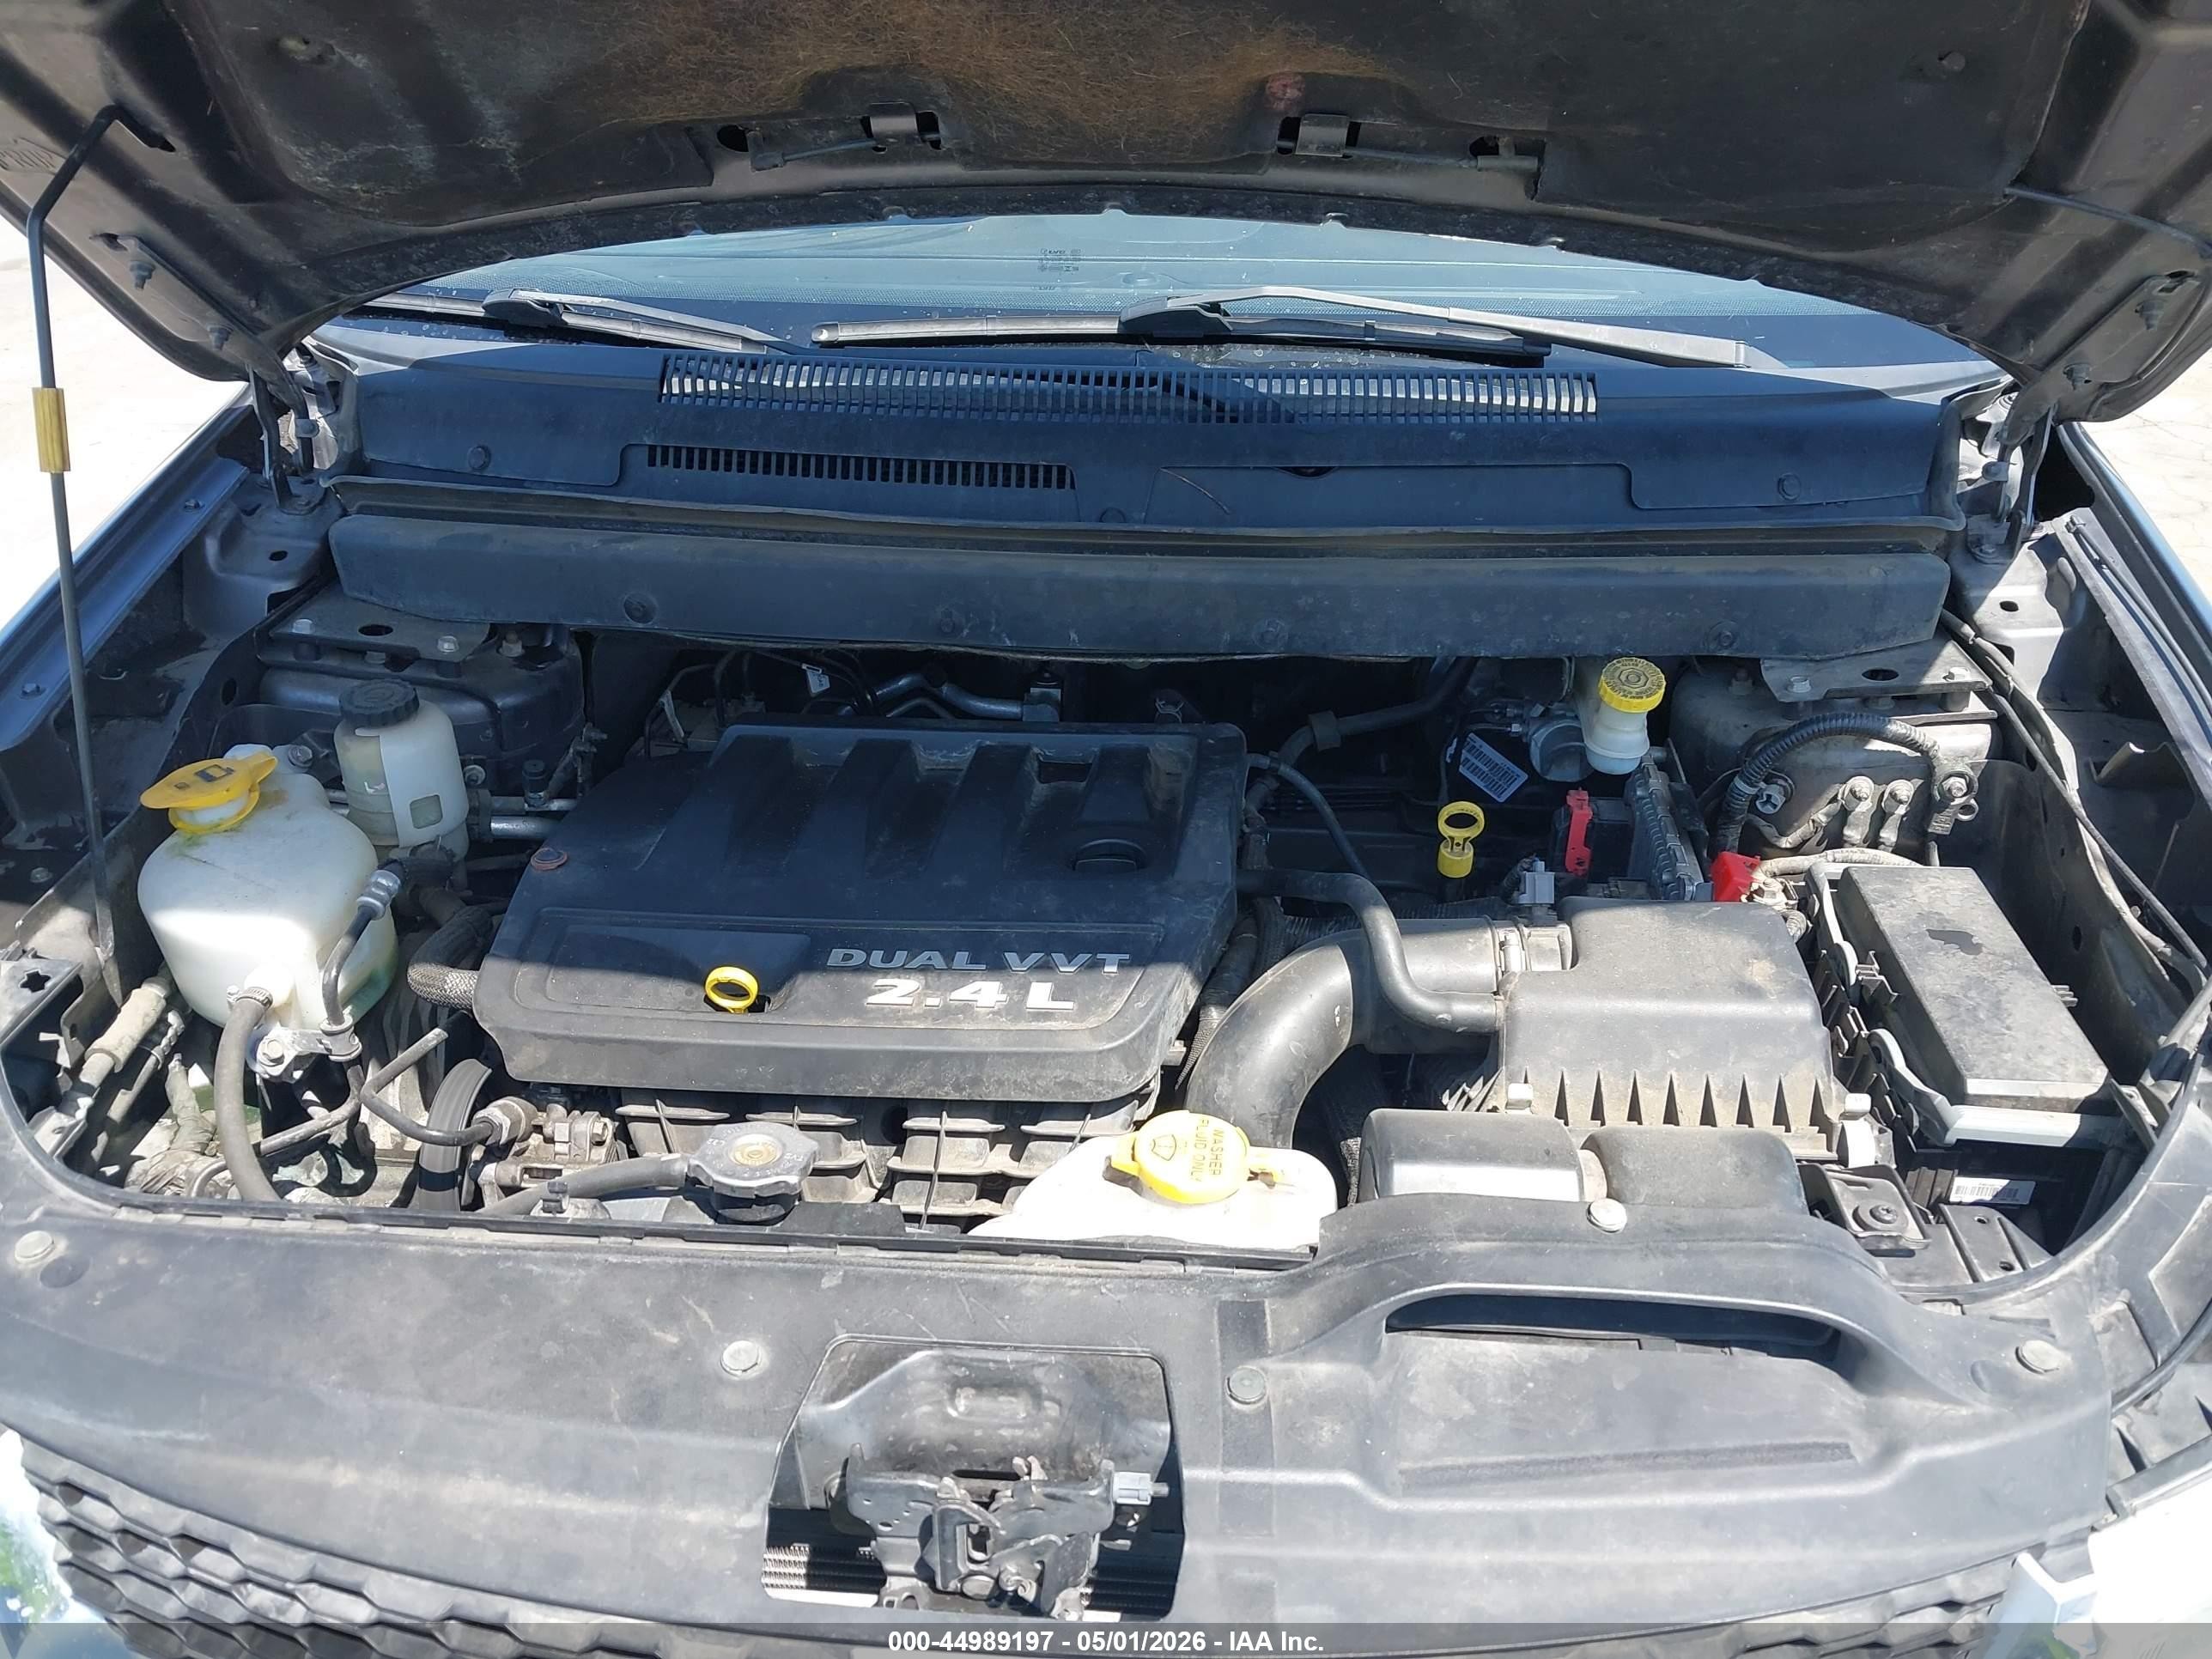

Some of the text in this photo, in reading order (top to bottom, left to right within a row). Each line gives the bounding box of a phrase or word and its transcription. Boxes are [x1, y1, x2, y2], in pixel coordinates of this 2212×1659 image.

[826, 947, 1130, 975] DUAL VVT
[1191, 1118, 1210, 1182] FLUID ONLY
[1209, 1128, 1224, 1176] WASHER
